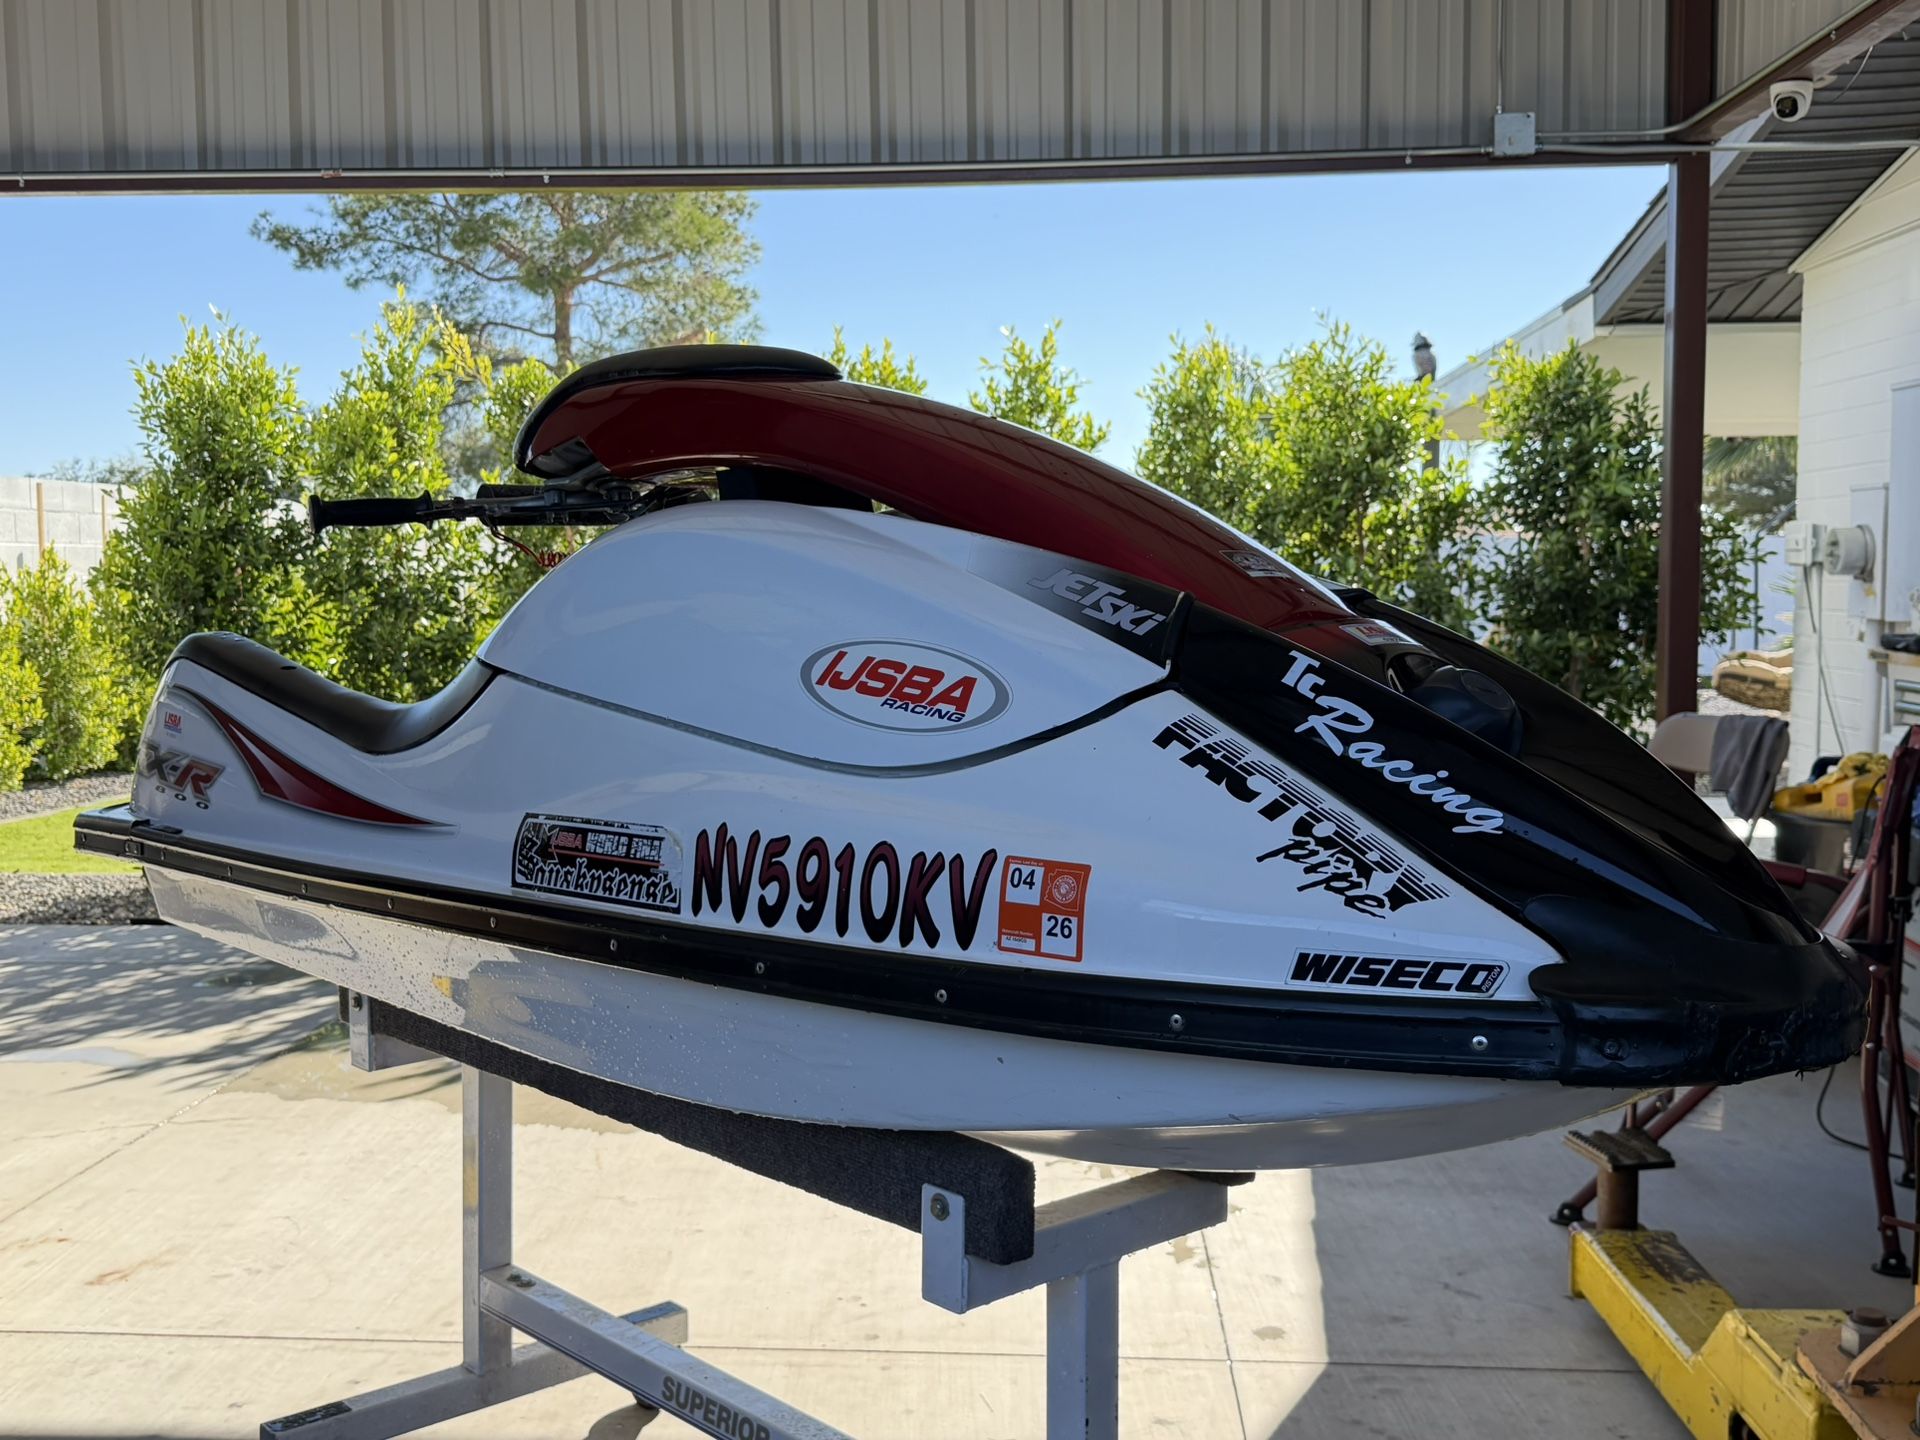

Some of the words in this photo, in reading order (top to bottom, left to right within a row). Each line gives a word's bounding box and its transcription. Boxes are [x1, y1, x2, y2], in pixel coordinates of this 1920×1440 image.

[815, 650, 978, 713] IJSBA
[880, 698, 966, 723] RACING
[1294, 695, 1505, 835] Racing
[1151, 712, 1451, 912] FACTORY
[691, 821, 998, 951] NV5910KV
[1010, 867, 1036, 890] 04
[1255, 827, 1386, 919] pipe
[1045, 915, 1073, 939] 26
[1290, 952, 1504, 994] WISECO
[1480, 966, 1501, 992] PISTON
